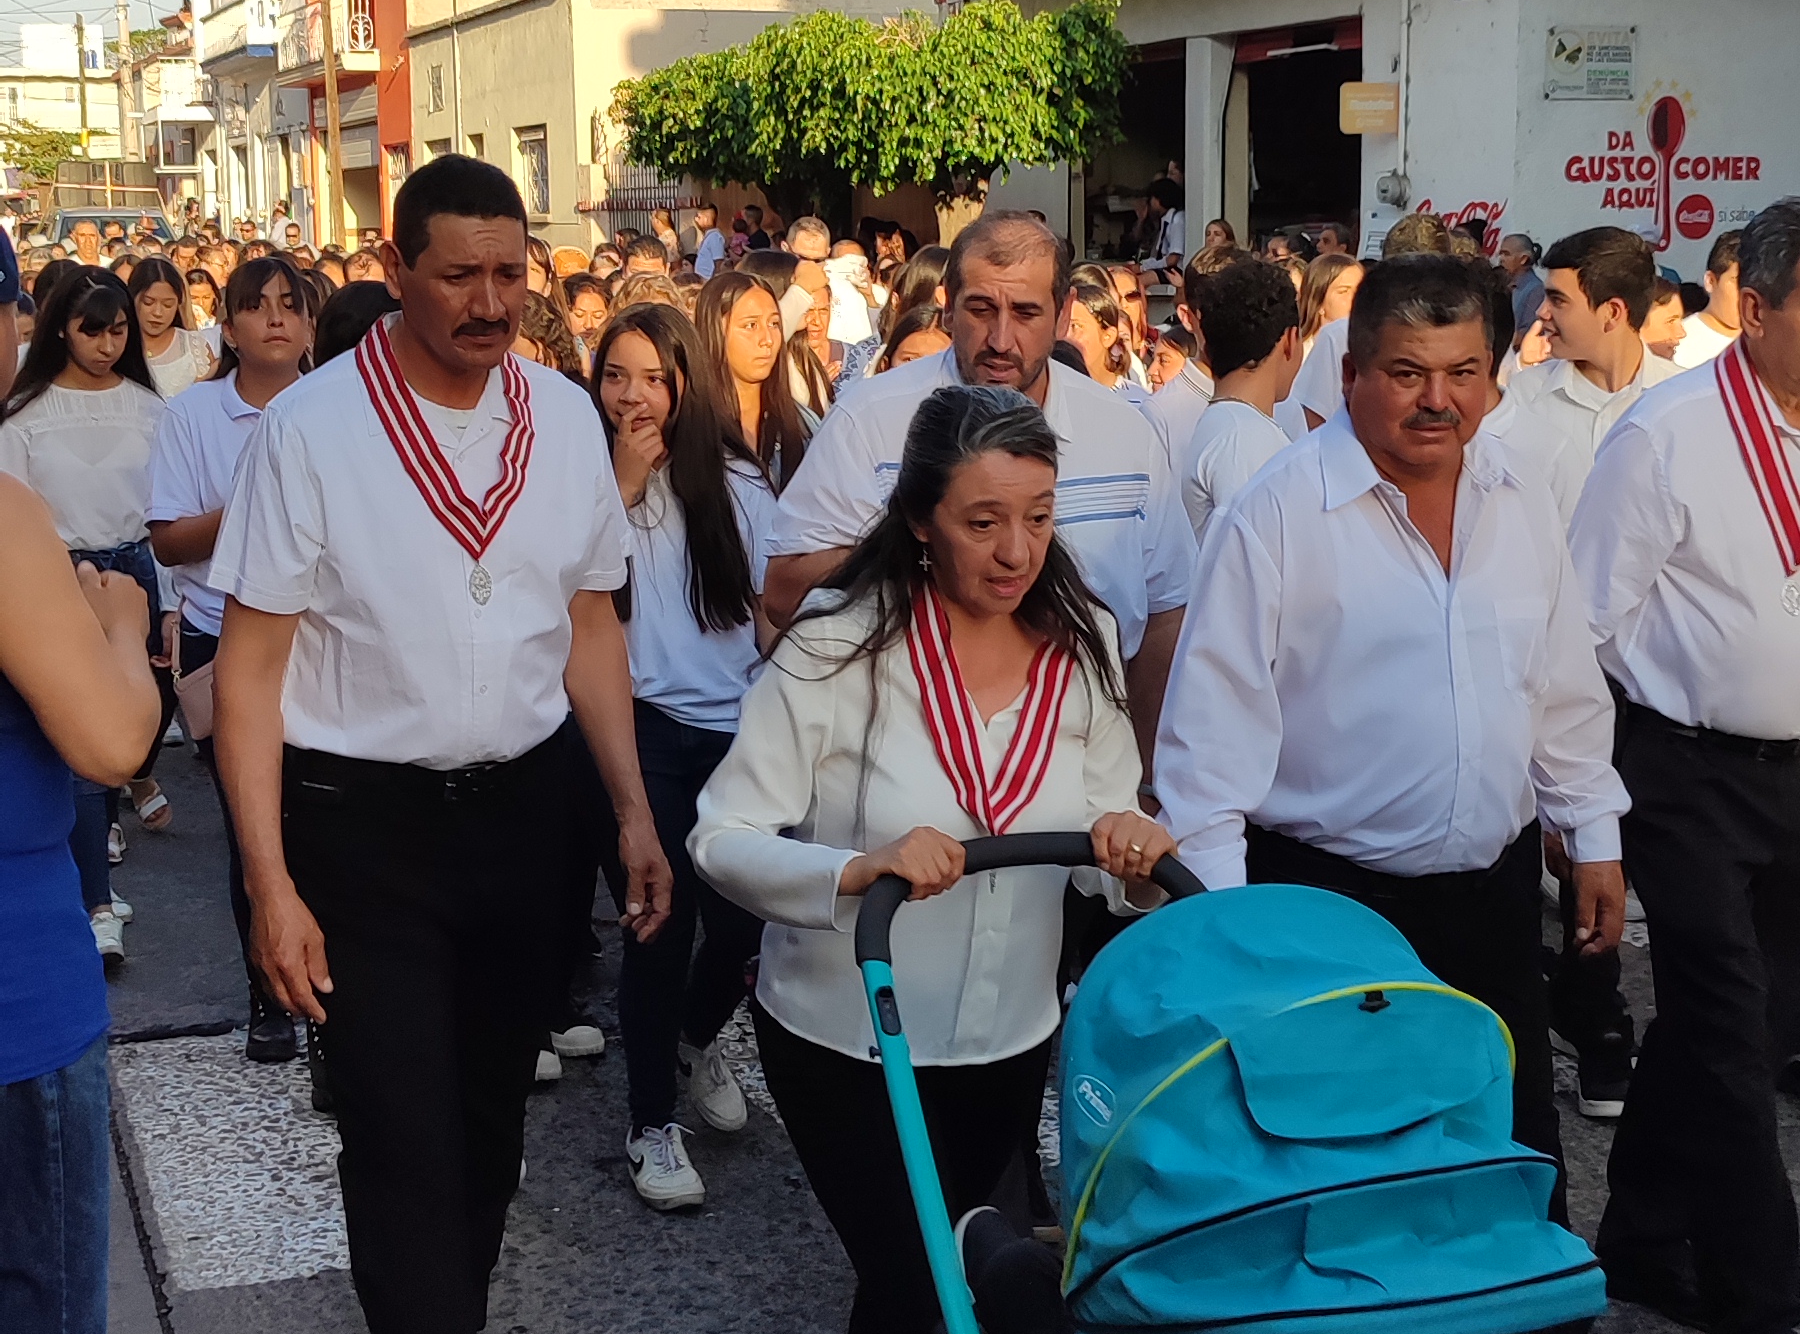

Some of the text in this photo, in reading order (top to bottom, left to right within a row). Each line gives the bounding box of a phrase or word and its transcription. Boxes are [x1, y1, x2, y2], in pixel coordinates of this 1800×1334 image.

[1607, 131, 1634, 152] DA
[1565, 156, 1760, 183] GUSTO COMER
[1601, 179, 1657, 211] AQUÍ
